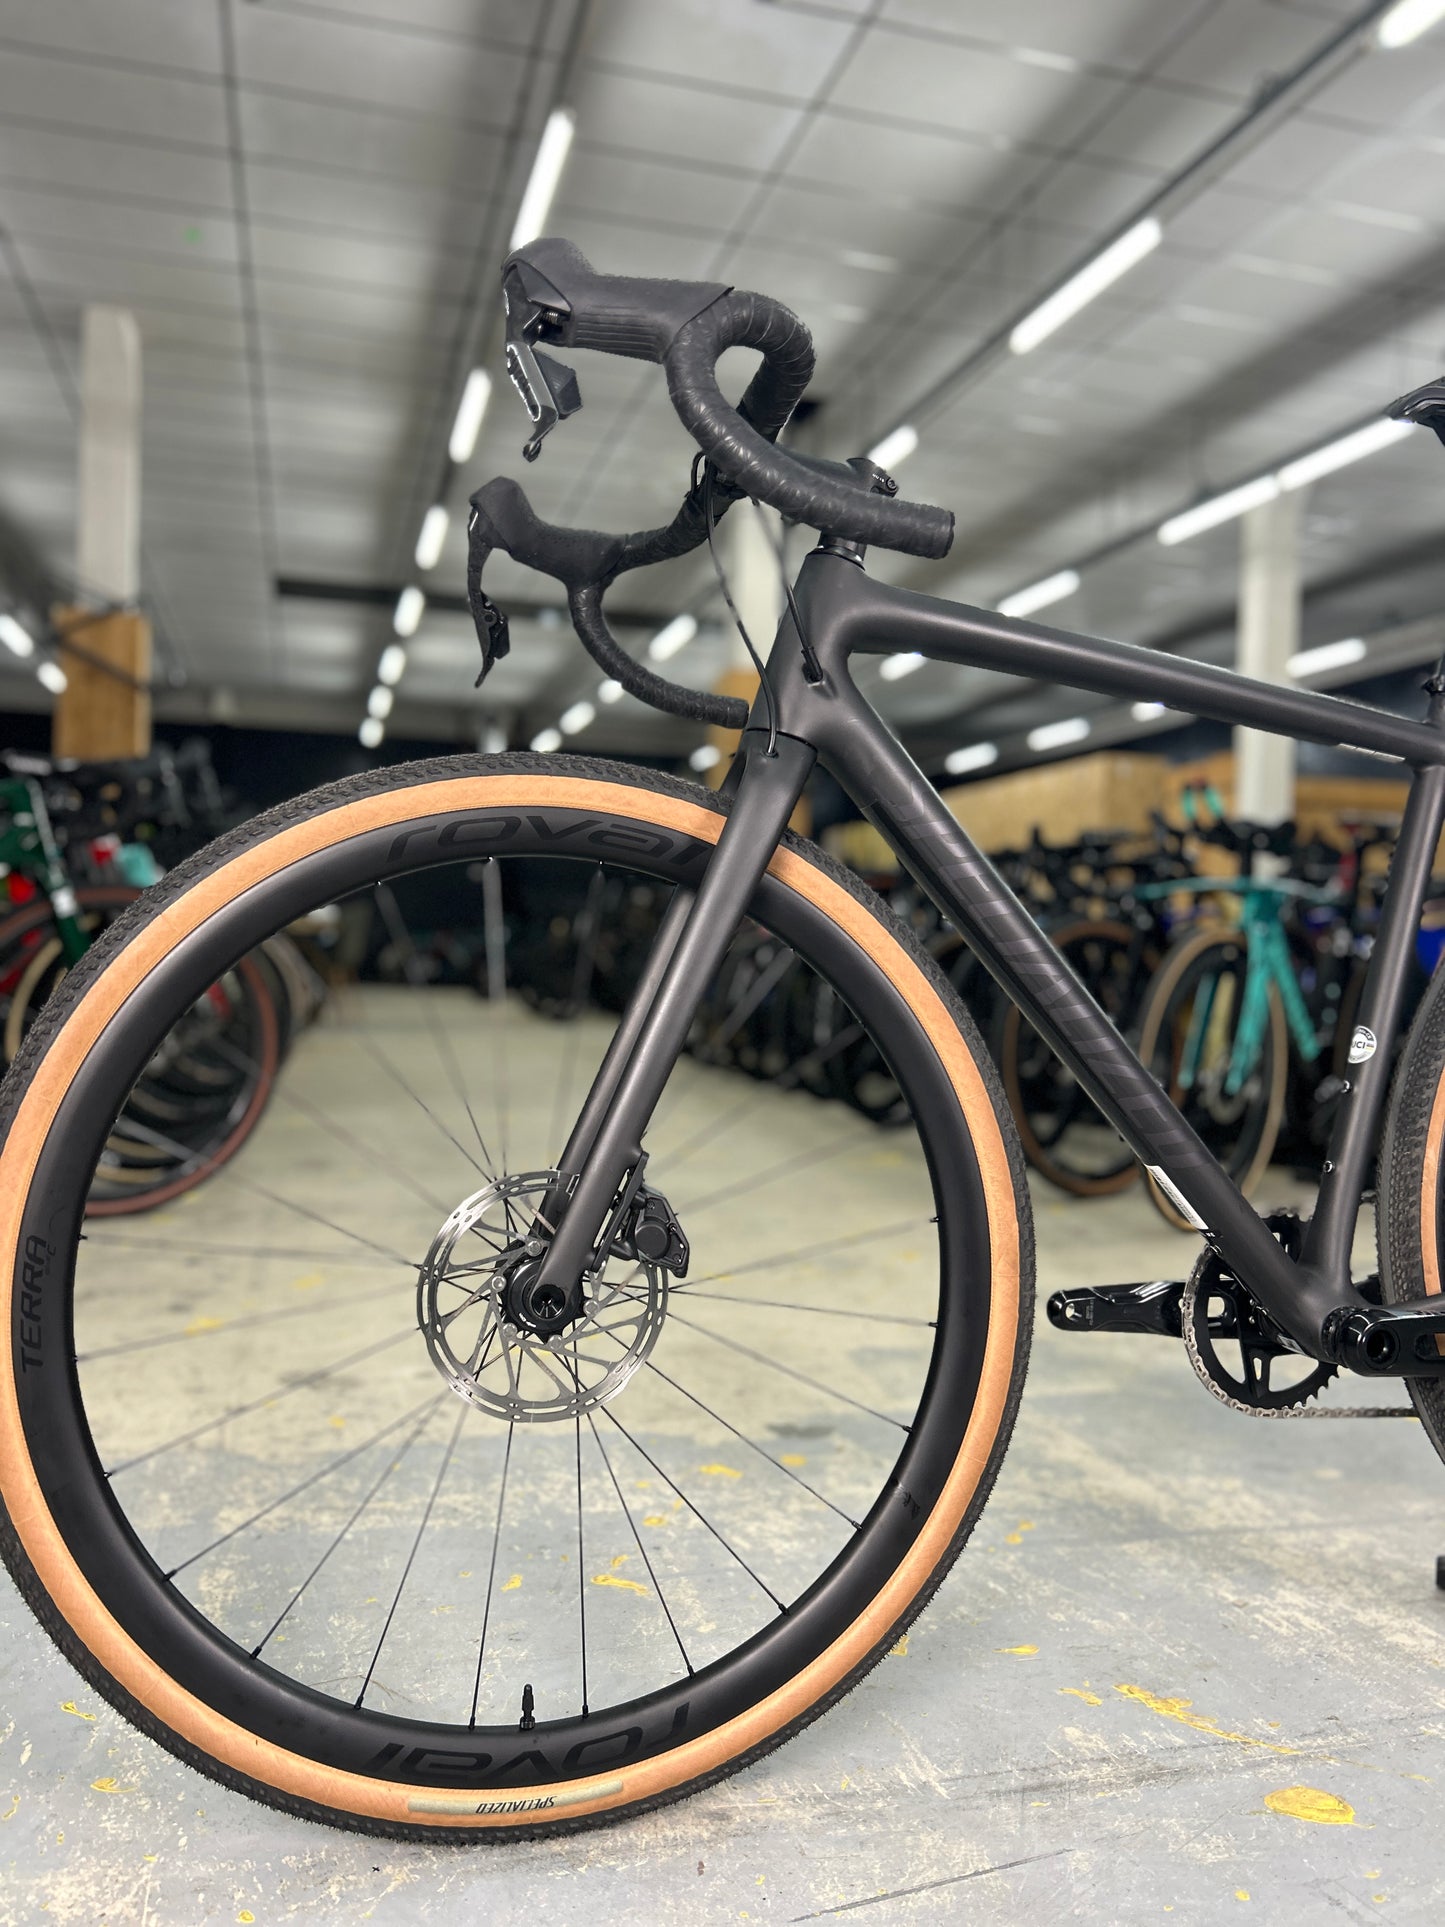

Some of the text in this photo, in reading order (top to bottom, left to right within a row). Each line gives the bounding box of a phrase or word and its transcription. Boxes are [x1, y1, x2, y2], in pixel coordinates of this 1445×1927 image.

[386, 815, 714, 865] roval
[884, 776, 1209, 1168] SPECIALIZED
[20, 1235, 47, 1374] TERRA
[362, 1702, 690, 1780] roval
[476, 1796, 557, 1814] SPECIALIZED
